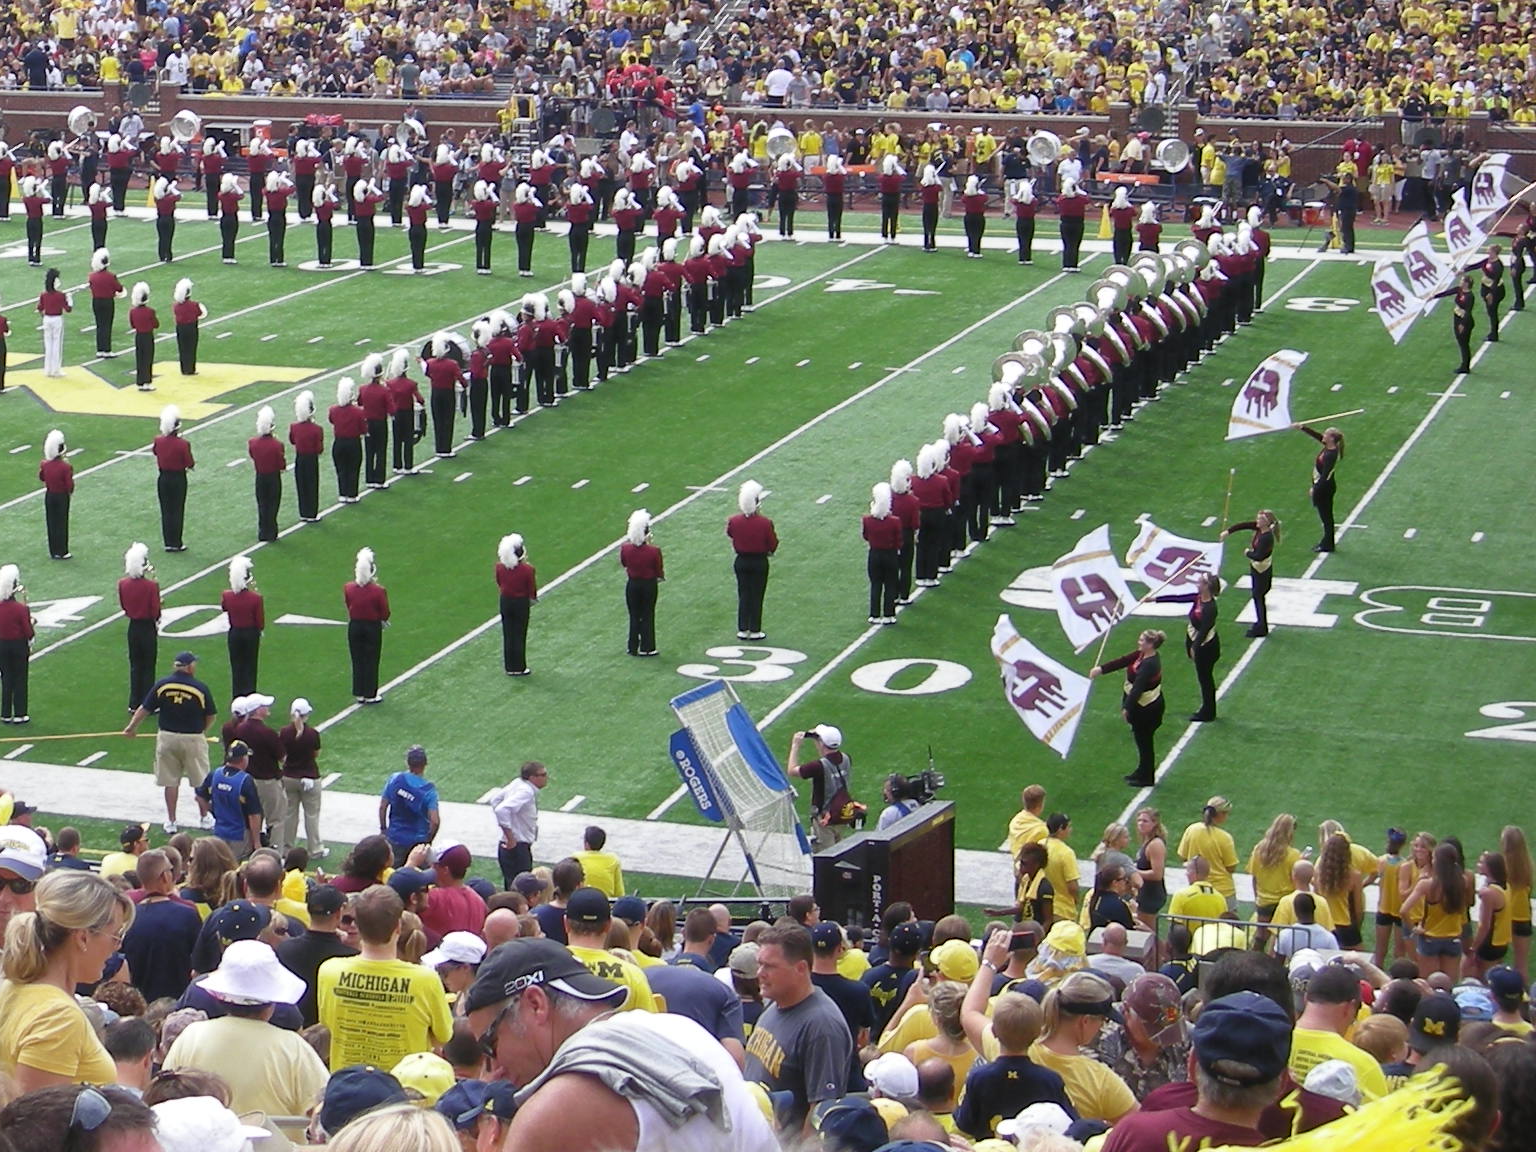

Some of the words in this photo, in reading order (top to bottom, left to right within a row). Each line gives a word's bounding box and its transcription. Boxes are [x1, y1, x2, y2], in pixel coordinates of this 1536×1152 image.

[675, 645, 974, 696] 30
[679, 757, 713, 811] ROGERS
[337, 971, 412, 995] MICHIGAN
[1423, 1016, 1446, 1036] M
